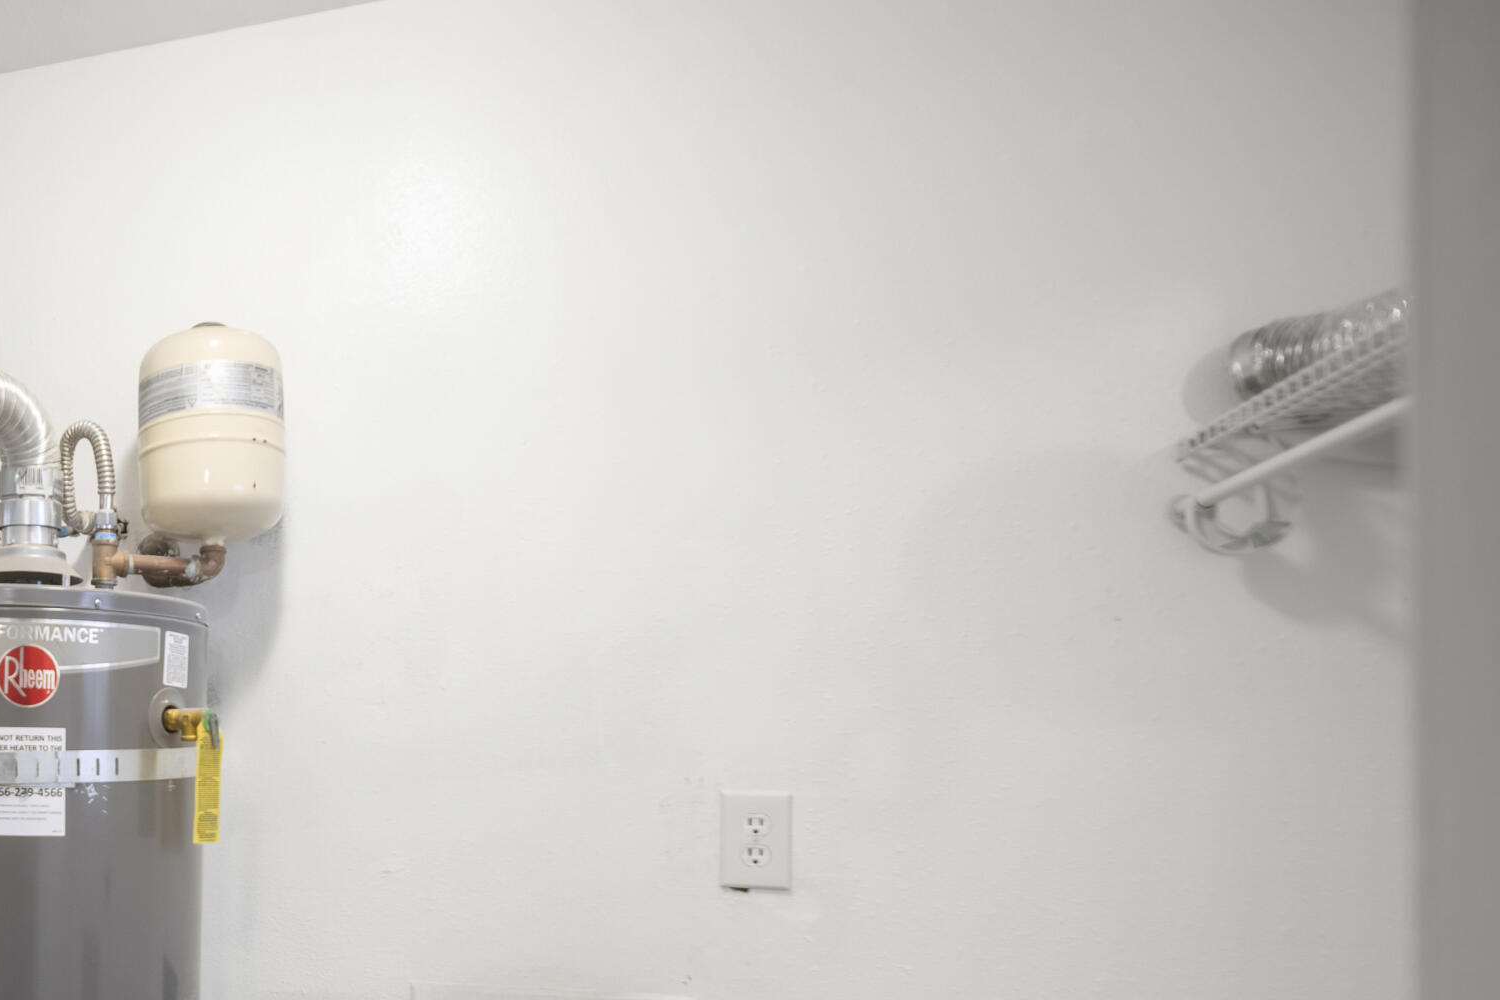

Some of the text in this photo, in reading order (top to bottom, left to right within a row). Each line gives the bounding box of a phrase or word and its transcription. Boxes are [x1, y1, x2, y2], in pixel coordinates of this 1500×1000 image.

[4, 646, 56, 698] Rheem
[15, 734, 45, 742] RETURN
[39, 744, 49, 752] TO
